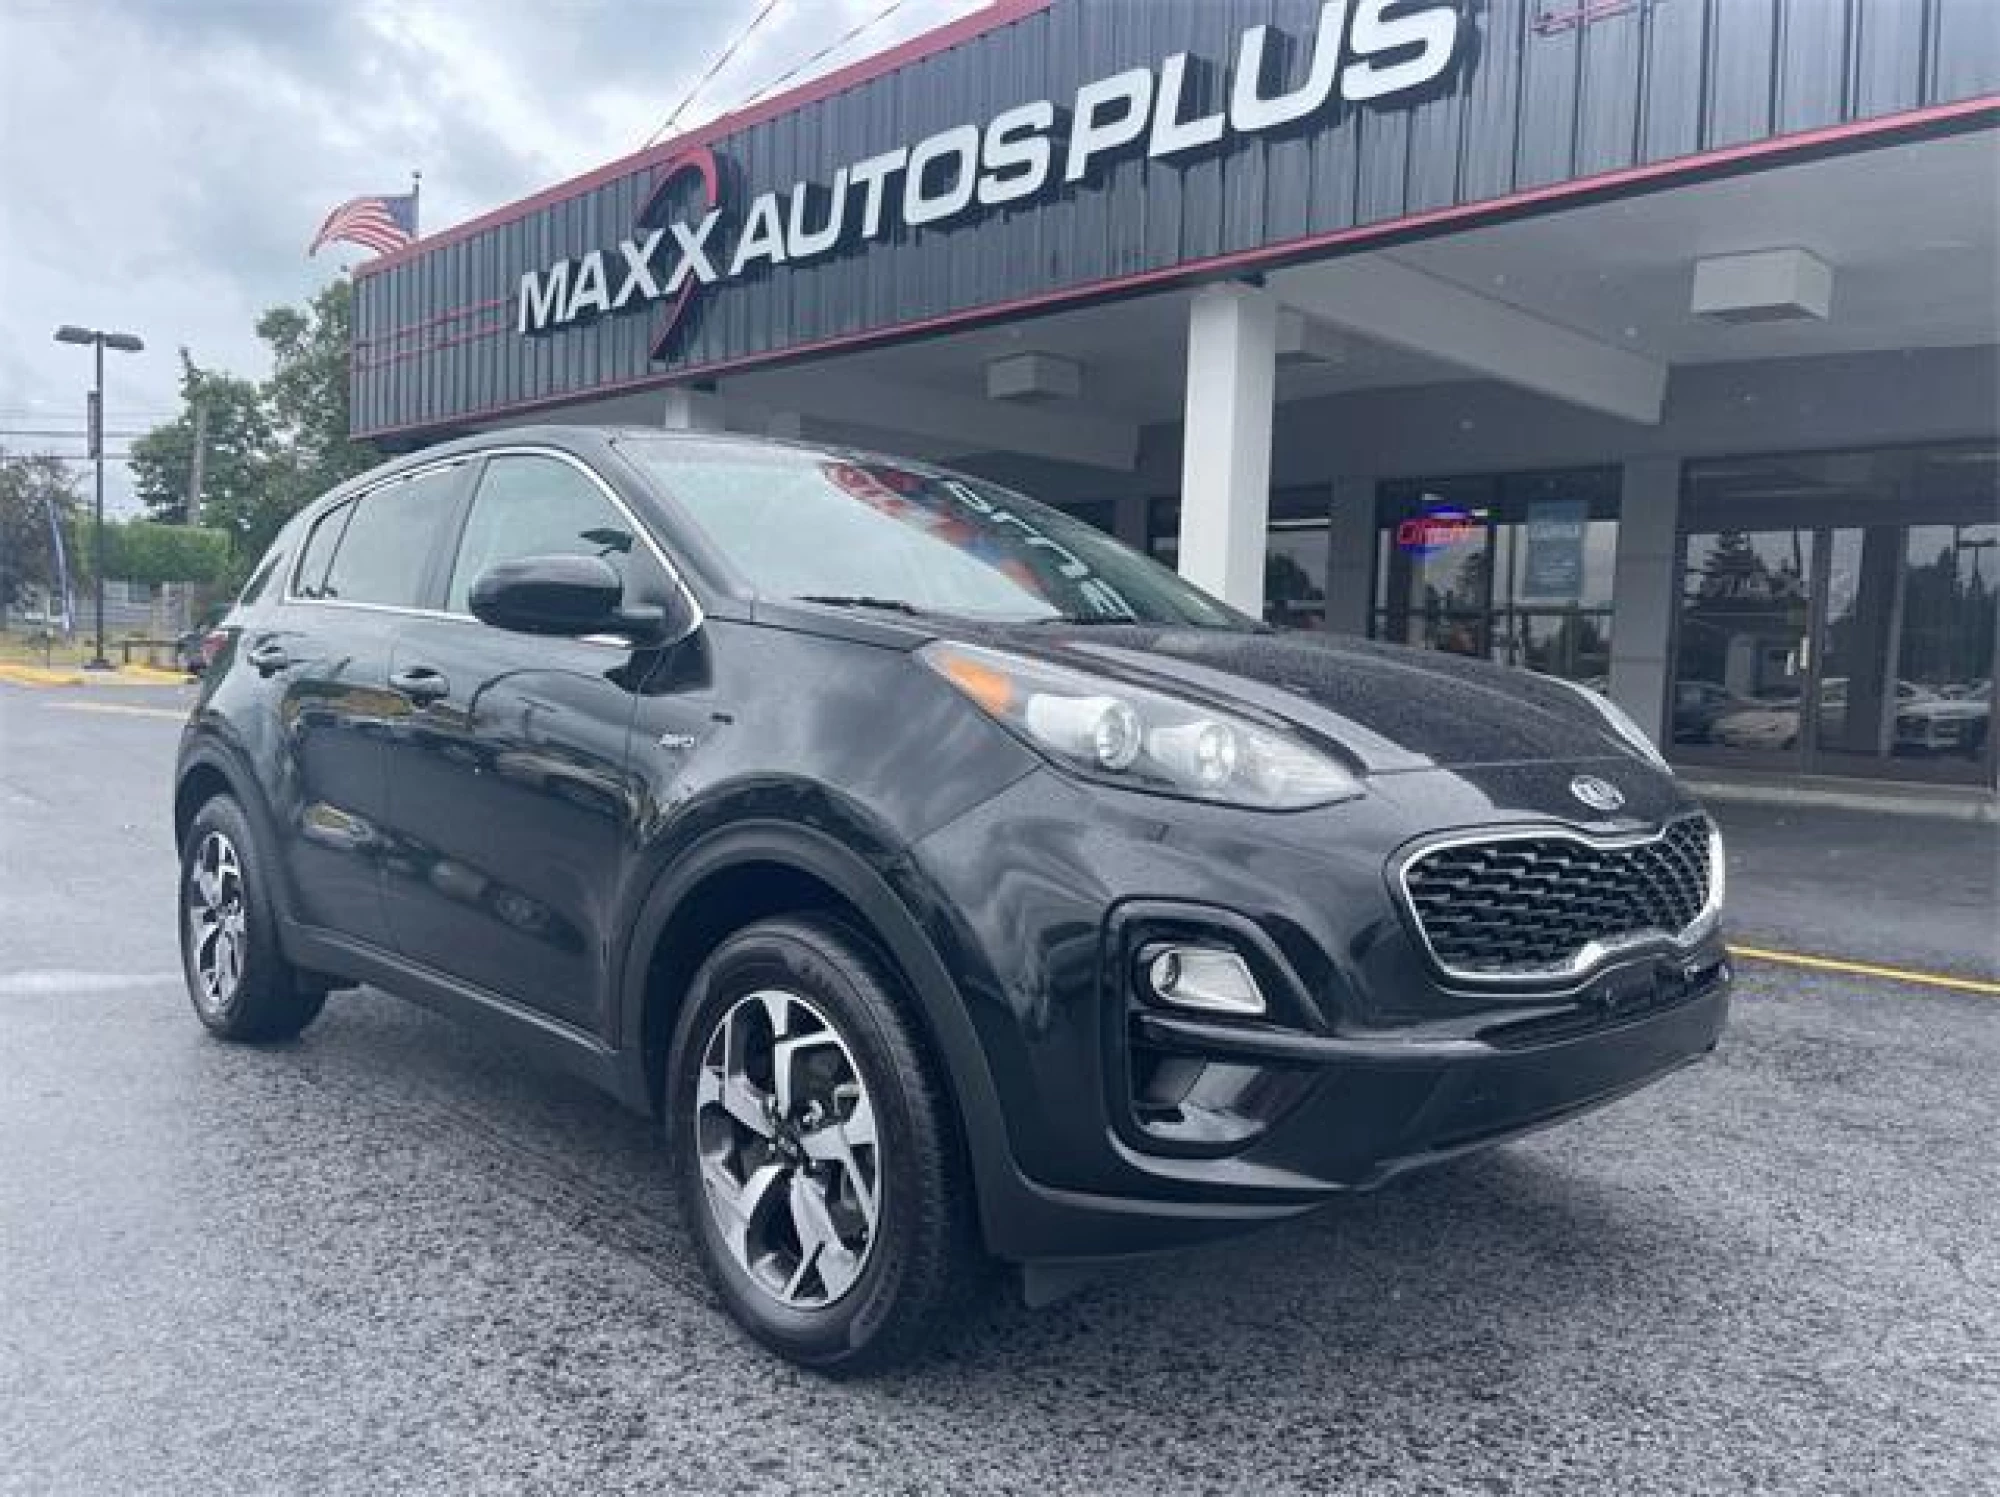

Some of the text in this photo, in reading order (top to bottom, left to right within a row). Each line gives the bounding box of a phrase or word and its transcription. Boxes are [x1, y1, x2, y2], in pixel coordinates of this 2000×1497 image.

[518, 0, 1457, 332] MAXX AUTOS PLUS
